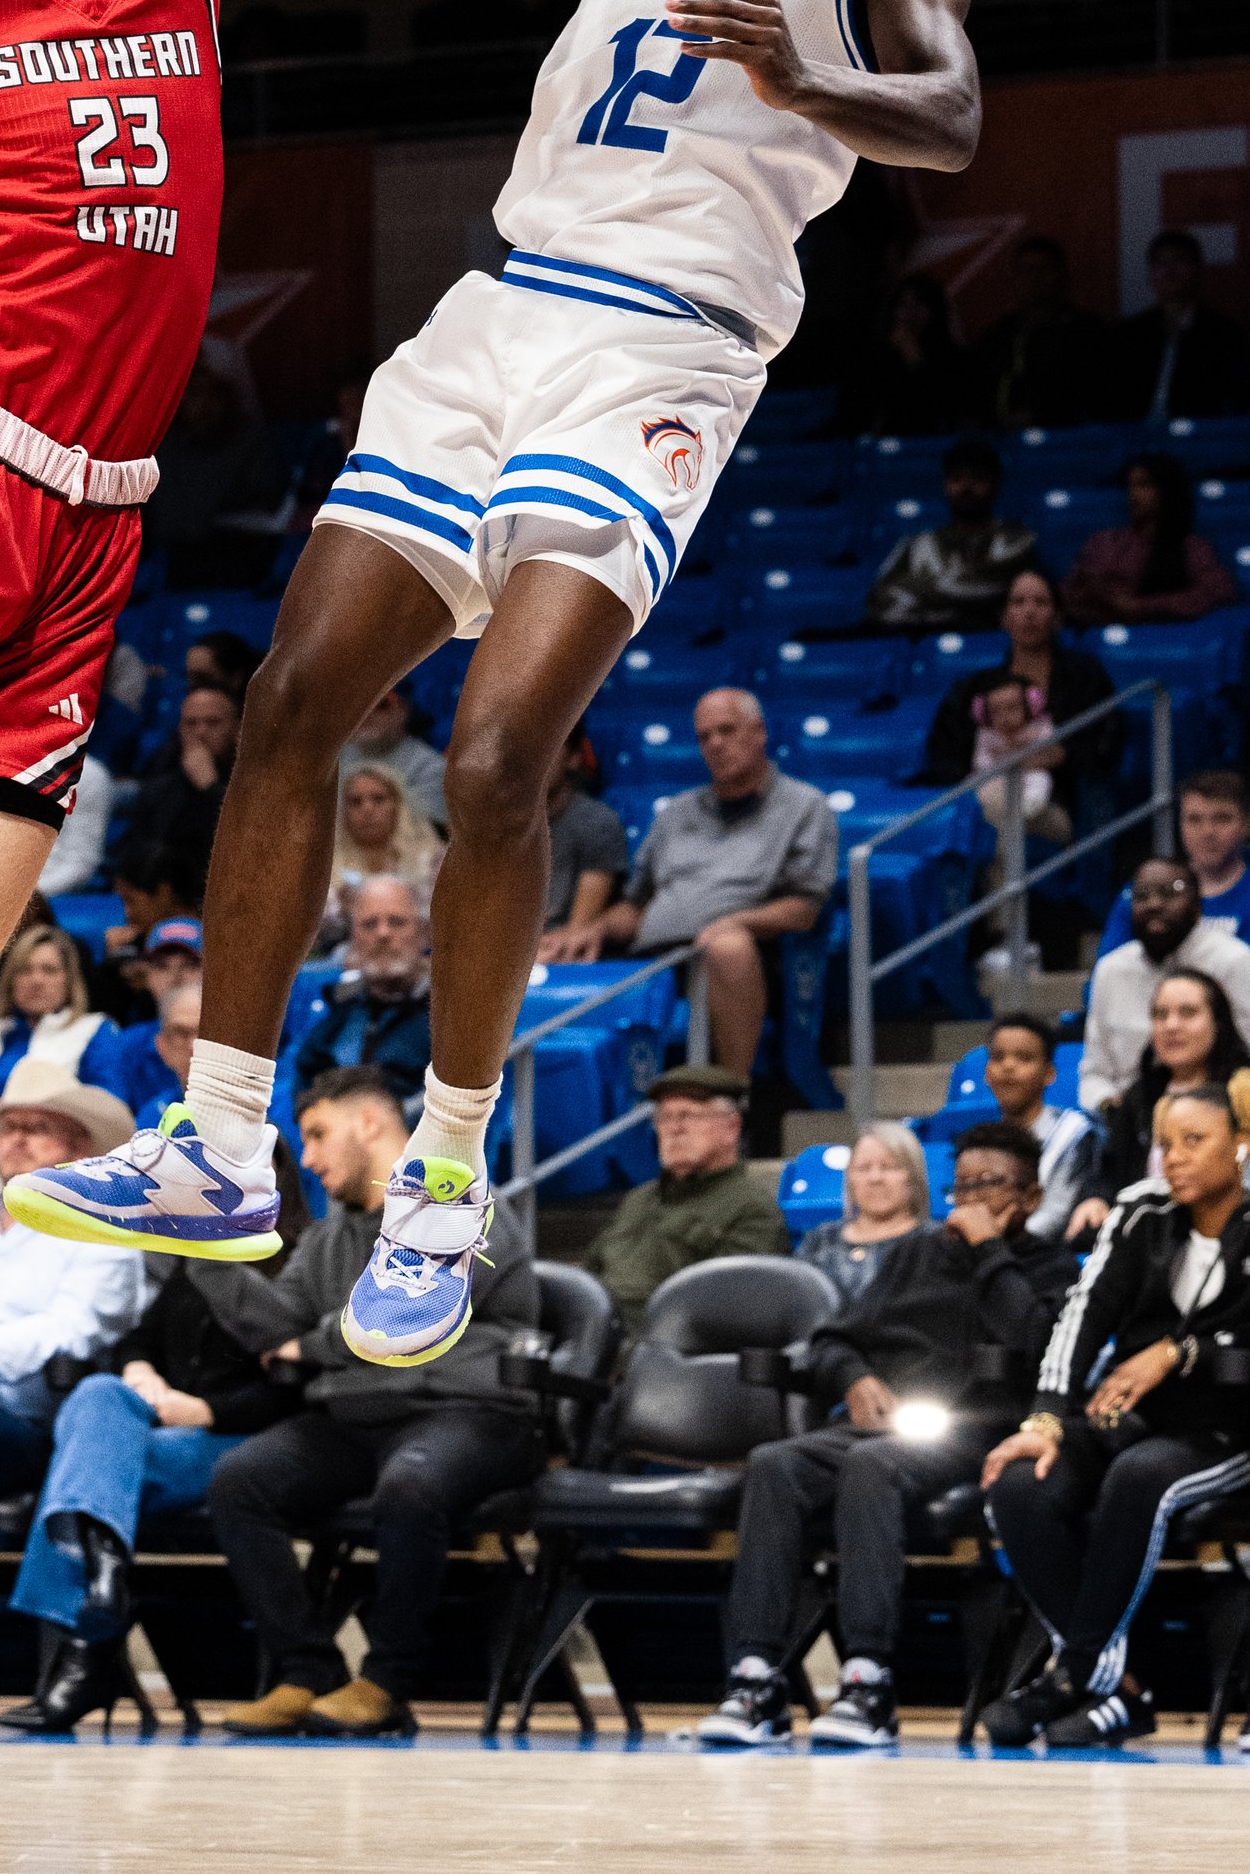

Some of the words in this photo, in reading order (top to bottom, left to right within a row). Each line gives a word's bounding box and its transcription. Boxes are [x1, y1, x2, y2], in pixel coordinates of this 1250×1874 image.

[576, 18, 714, 154] 12
[68, 96, 171, 188] 23
[75, 205, 180, 257] UTAH
